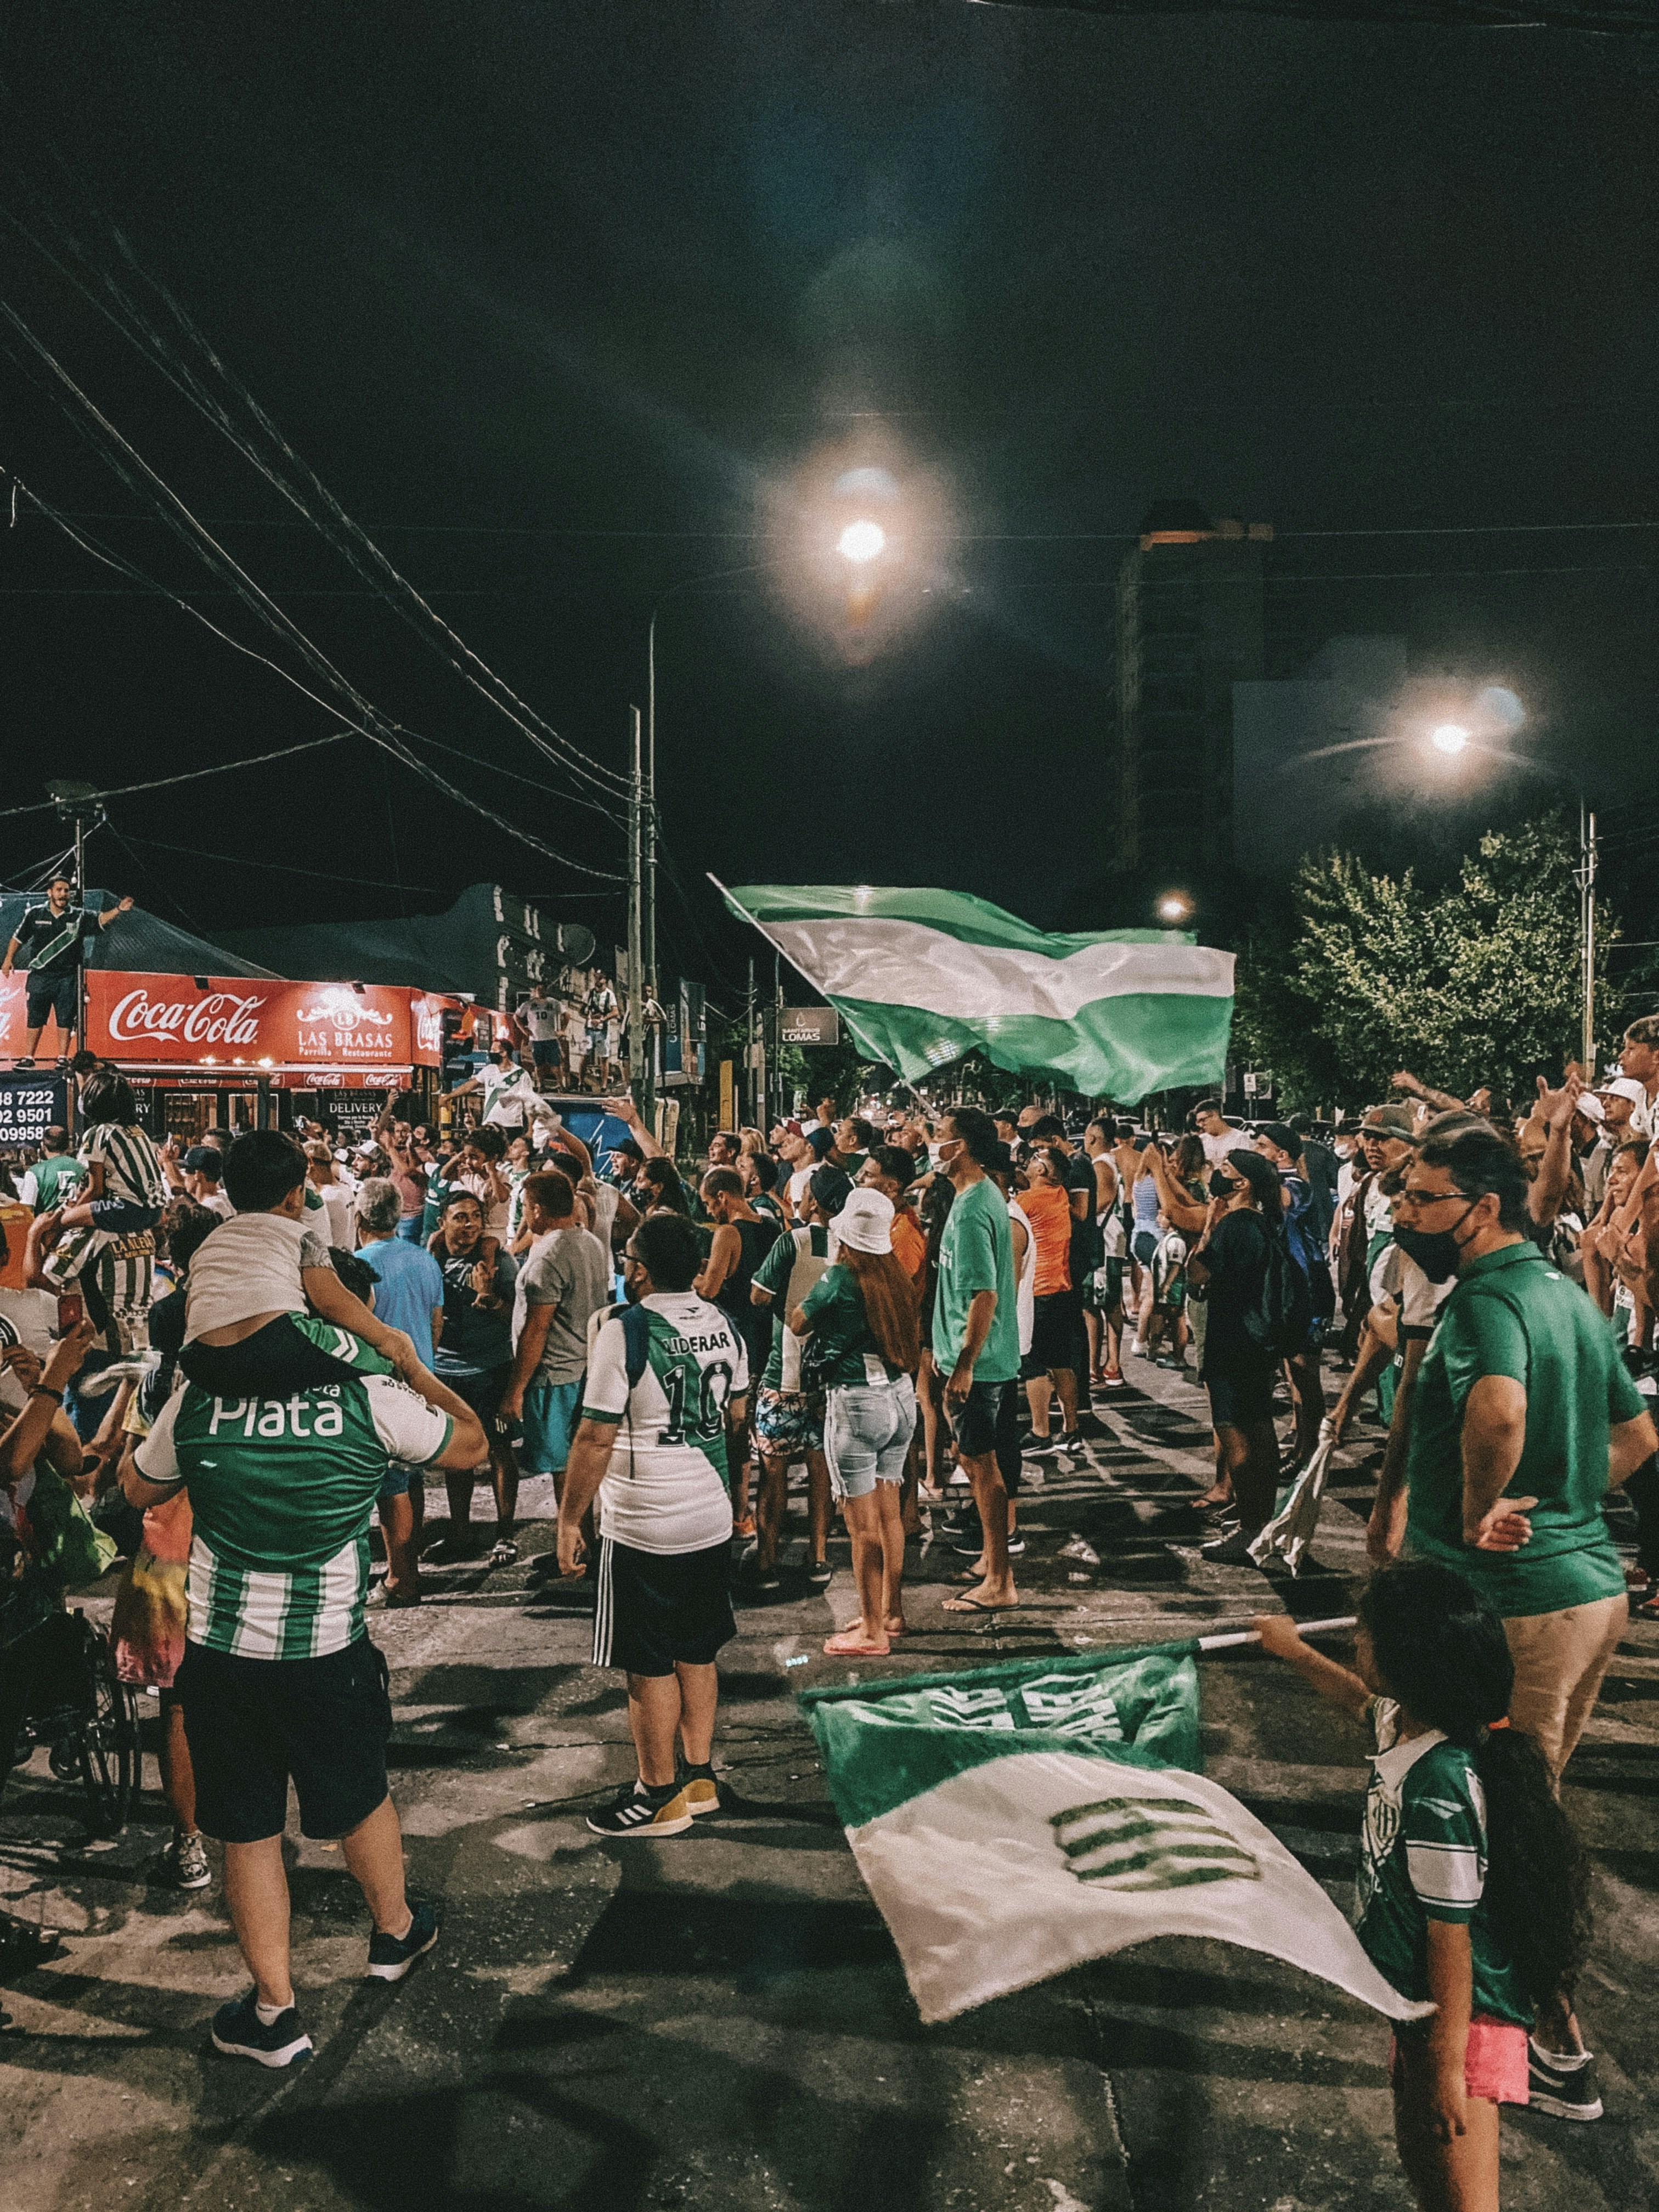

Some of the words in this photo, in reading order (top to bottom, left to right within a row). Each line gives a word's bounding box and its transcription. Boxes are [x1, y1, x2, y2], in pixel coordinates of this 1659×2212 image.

[109, 989, 267, 1044] Coca-Cola
[298, 1031, 327, 1047] LAS
[335, 1032, 393, 1048] BRASAS
[782, 1032, 820, 1041] LOMAS
[299, 1046, 332, 1056] Parrilla
[342, 1047, 392, 1057] Restaurante
[17, 1090, 54, 1105] 7222
[16, 1108, 52, 1122] 9501
[330, 1103, 382, 1113] DELIVERY
[0, 1126, 51, 1141] 09958
[662, 1331, 731, 1356] LIDERAR
[656, 1358, 733, 1447] 10
[209, 1392, 343, 1437] Plata
